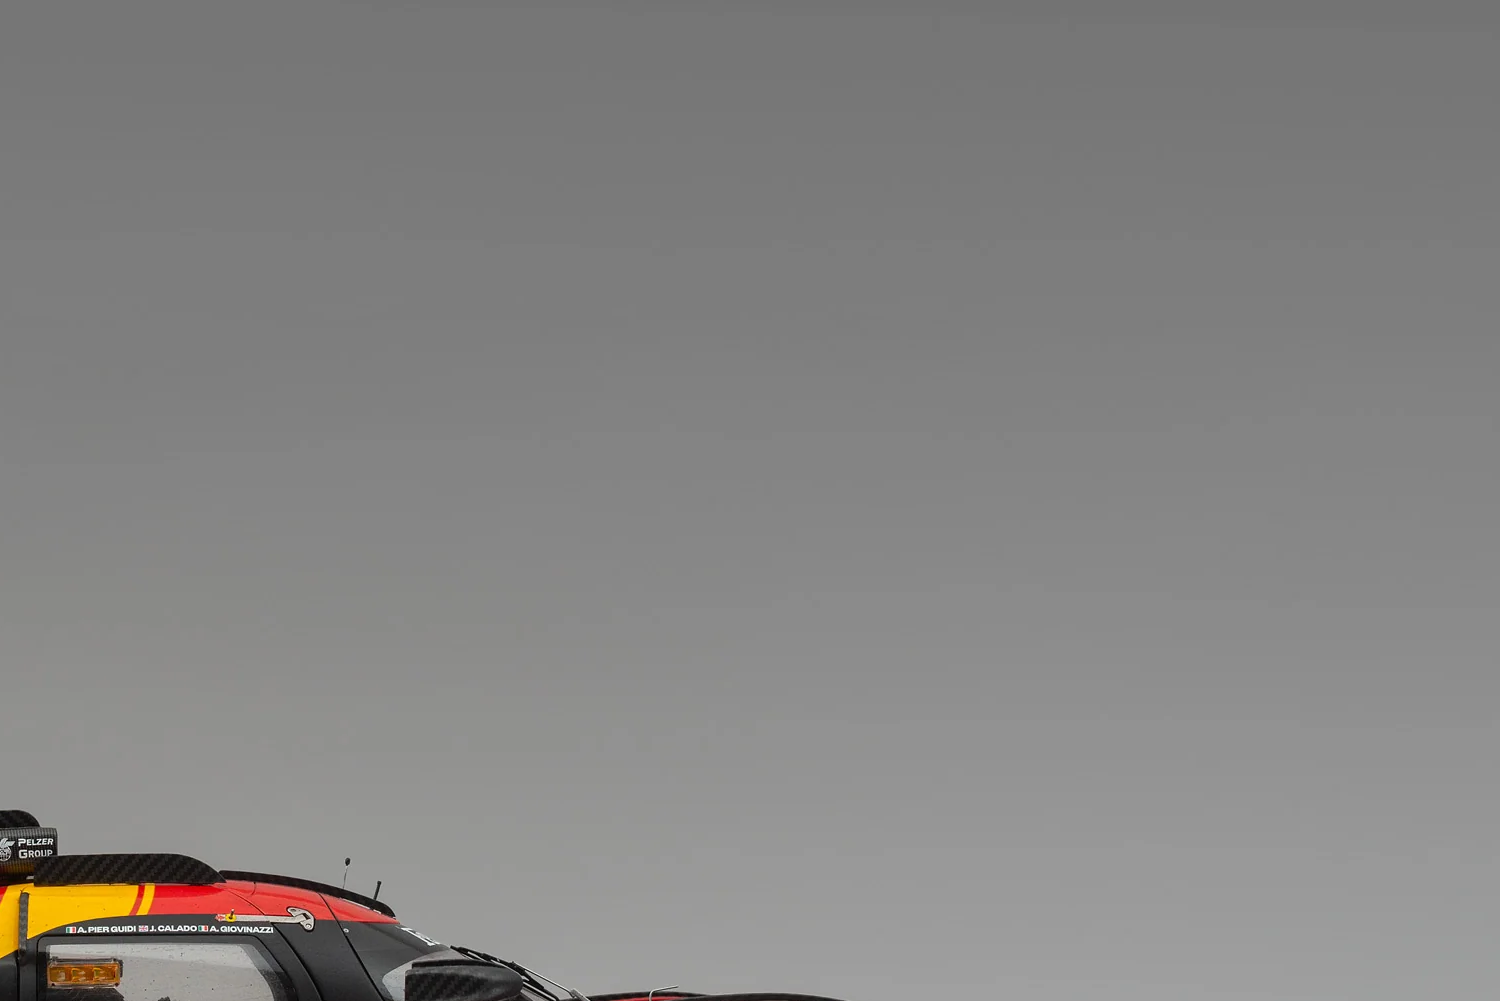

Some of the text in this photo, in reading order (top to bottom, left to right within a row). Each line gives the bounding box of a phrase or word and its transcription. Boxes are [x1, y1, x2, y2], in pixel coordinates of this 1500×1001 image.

[18, 837, 54, 847] PELZER
[111, 925, 137, 933] GUIDI
[220, 926, 274, 934] GIOVINAZZI
